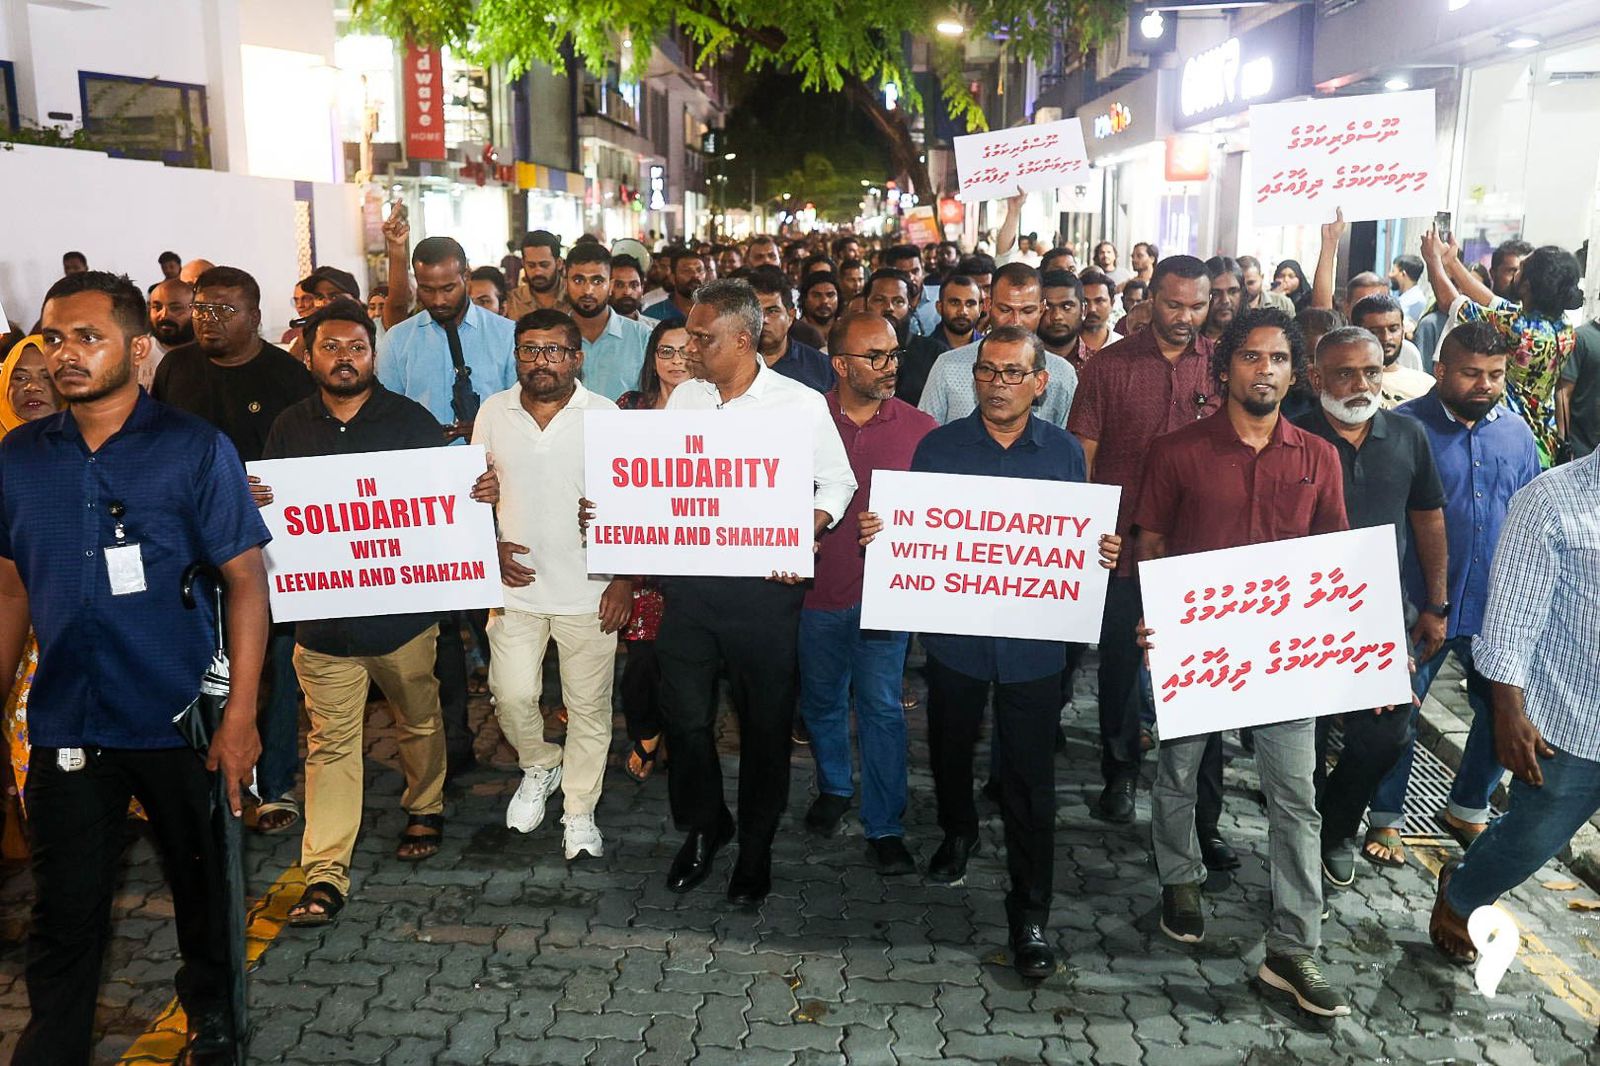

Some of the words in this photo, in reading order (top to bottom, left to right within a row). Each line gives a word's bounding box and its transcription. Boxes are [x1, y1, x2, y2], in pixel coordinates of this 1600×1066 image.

[410, 132, 441, 141] HOME
[685, 434, 704, 454] IN
[612, 457, 779, 488] SOLIDARITY
[356, 478, 377, 498] IN
[283, 495, 455, 536] SOLIDARITY
[671, 497, 720, 518] WITH
[594, 525, 669, 545] LEEVAAN
[674, 526, 711, 546] AND
[716, 527, 799, 547] SHAHZAN
[893, 510, 914, 526] IN
[926, 507, 1090, 538] SOLIDARITY
[349, 538, 401, 560] WITH
[892, 542, 948, 560] WITH
[955, 541, 1086, 570] LEEVAAN
[274, 569, 355, 593] LEEVAAN
[358, 567, 397, 588] AND
[399, 560, 486, 585] SHAHZAN
[890, 573, 936, 592] AND
[944, 572, 1081, 601] SHAHZAN
[1265, 631, 1396, 675] މިނިވަންކަމުގެ
